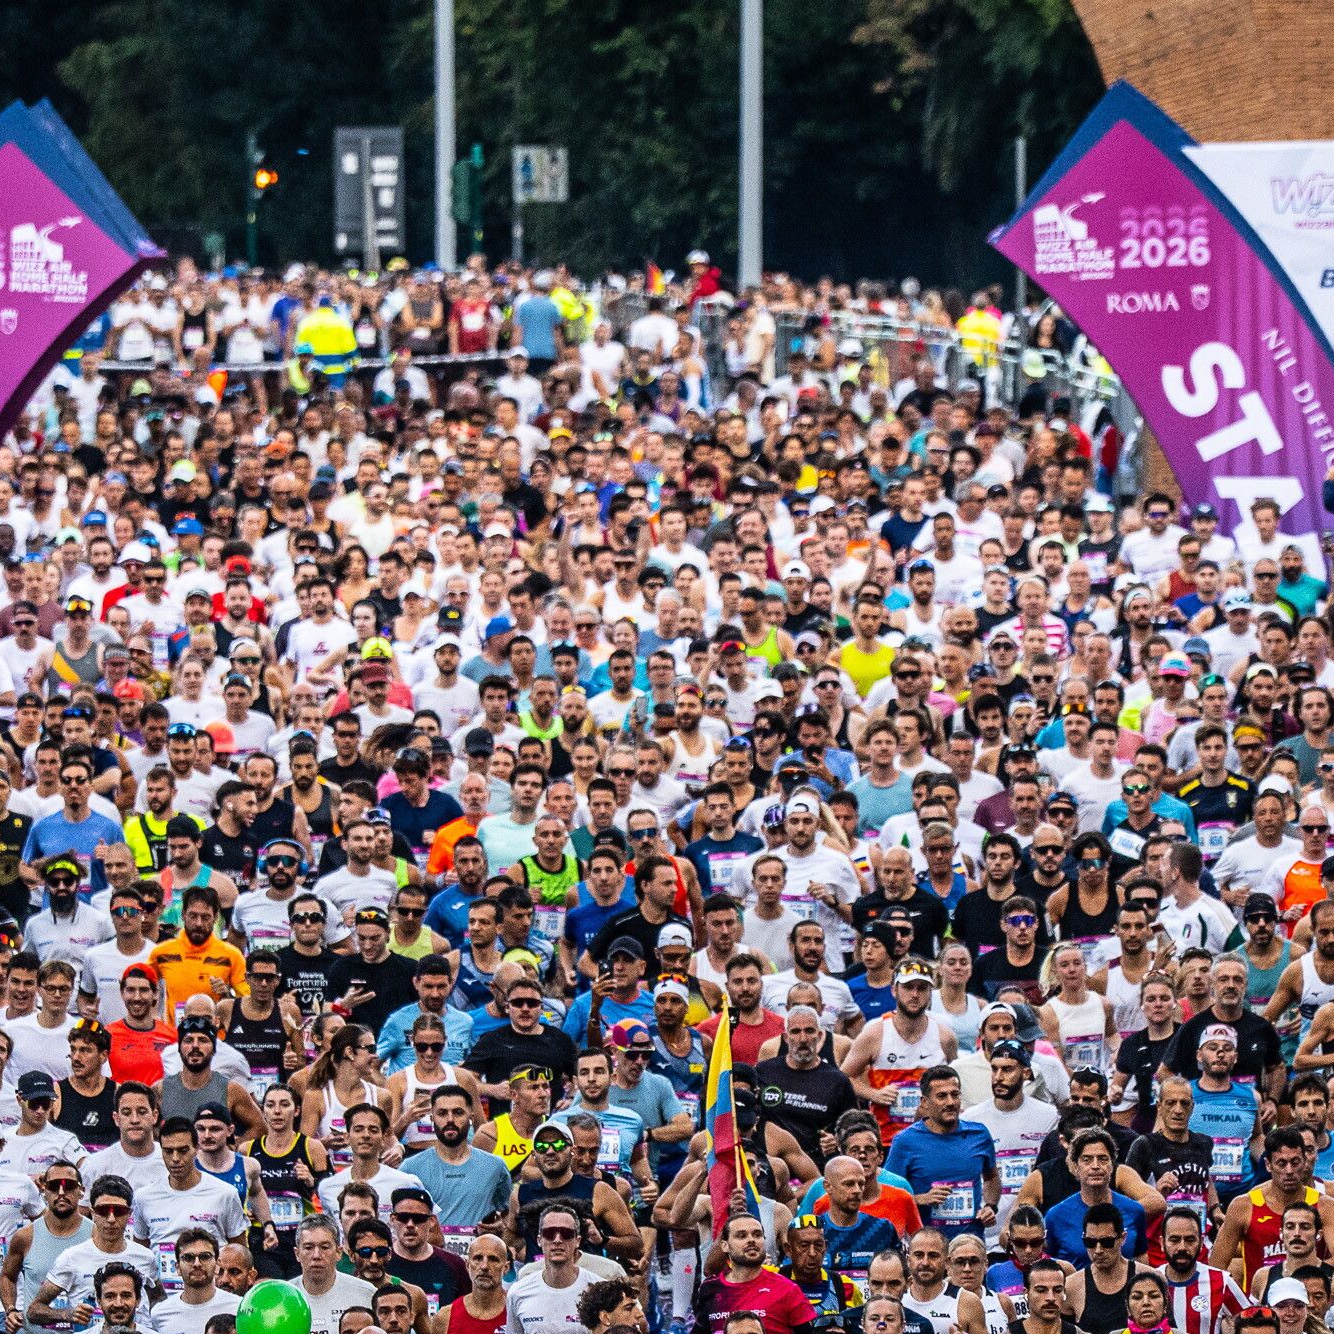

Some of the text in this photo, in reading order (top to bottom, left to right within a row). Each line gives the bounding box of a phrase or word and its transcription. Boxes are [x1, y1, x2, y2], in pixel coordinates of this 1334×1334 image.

[1121, 238, 1211, 269] 2026
[1035, 261, 1114, 274] MARATHON
[10, 282, 88, 295] MARATHON
[1106, 293, 1180, 316] ROMA
[1201, 1113, 1242, 1123] TRIKAIA
[503, 1144, 527, 1157] LAS
